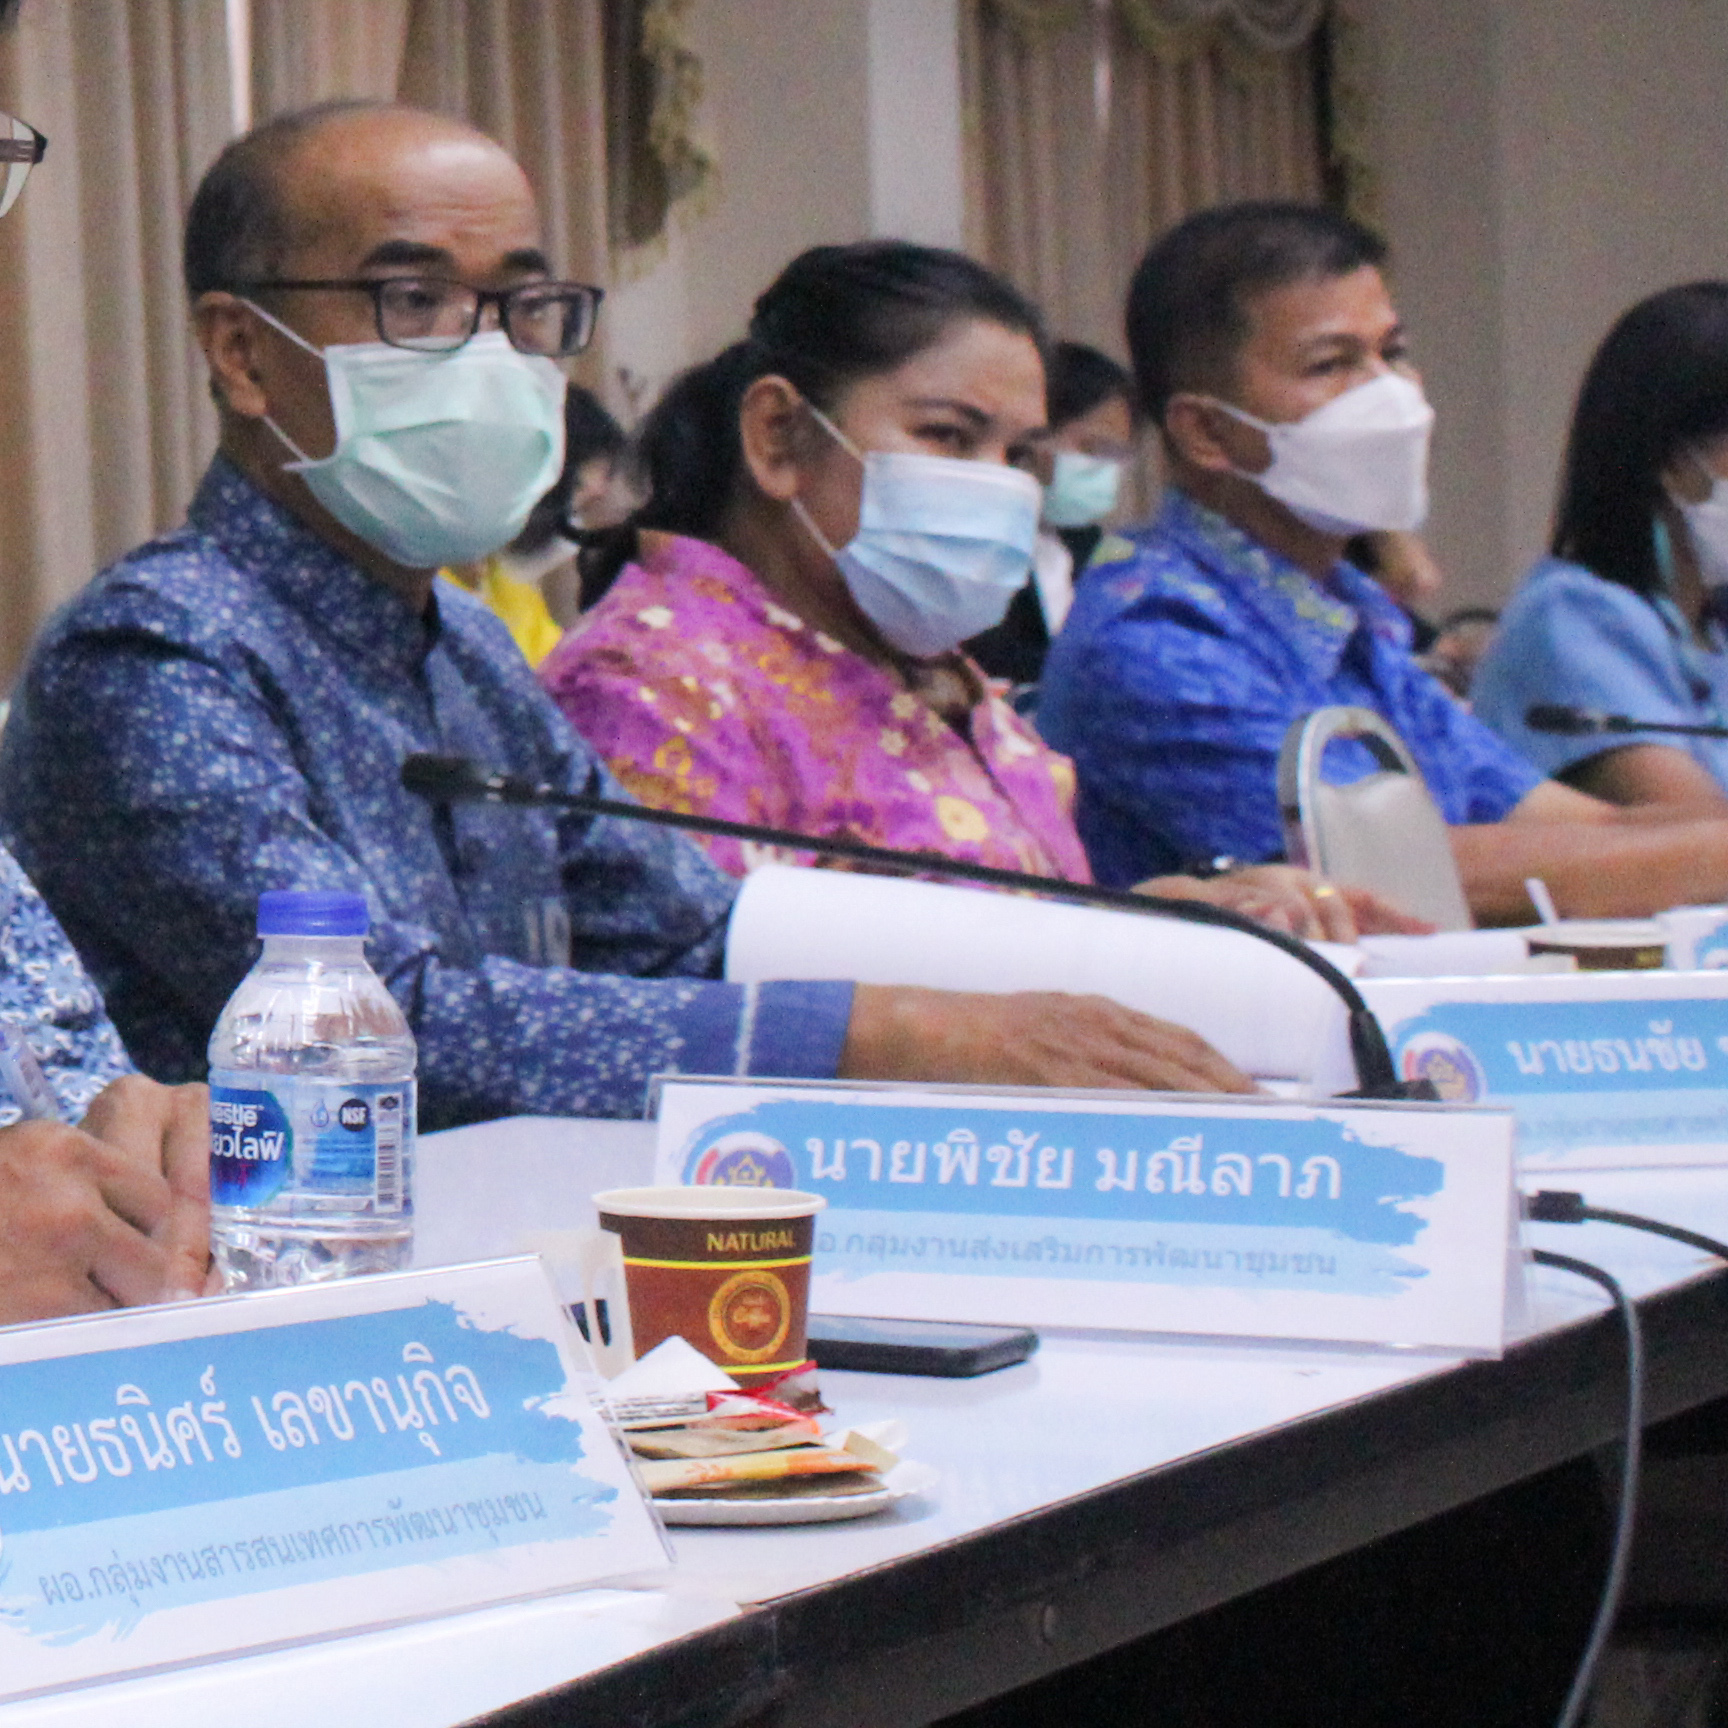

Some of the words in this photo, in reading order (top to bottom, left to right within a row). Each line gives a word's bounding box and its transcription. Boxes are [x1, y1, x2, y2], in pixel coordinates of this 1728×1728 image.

[1507, 1019, 1707, 1075] นายธนชัย
[807, 1130, 1071, 1190] นายพิชัย
[1096, 1138, 1342, 1200] มณีลาภ
[706, 1229, 797, 1253] NATURAL
[818, 1223, 1337, 1279] อ.กลุ่มงานส่งเสริมการพัฒนาชุมชน
[250, 1341, 490, 1464] เลขานุกิจ
[38, 1489, 546, 1610] ผอ.กลุ่มงานสารสนเทศการพัฒนาชุมชน
